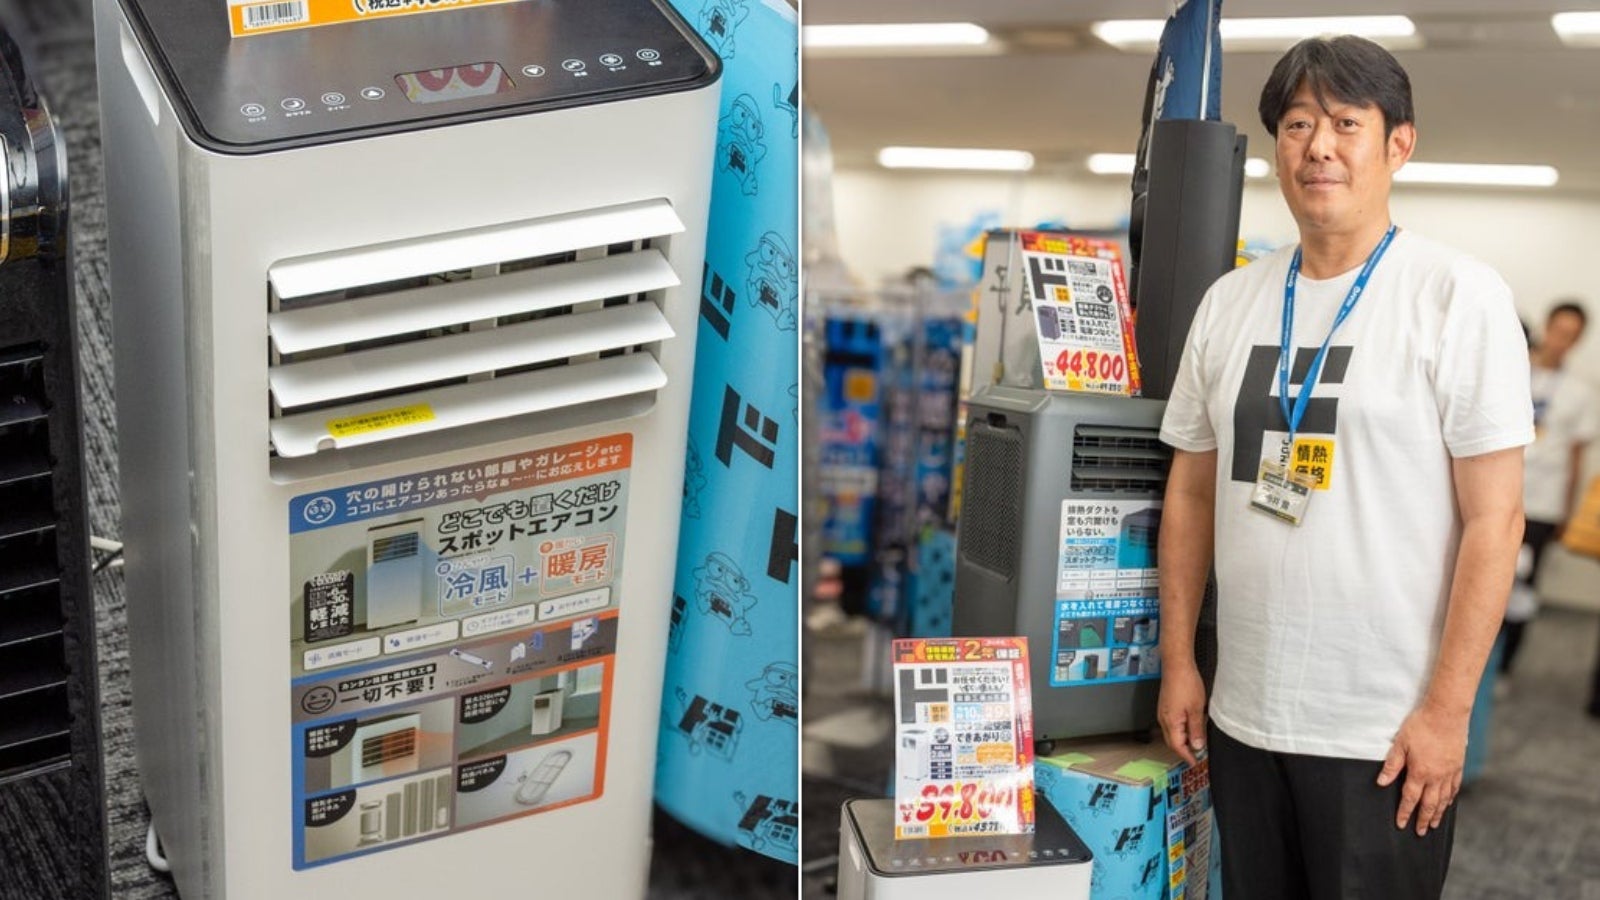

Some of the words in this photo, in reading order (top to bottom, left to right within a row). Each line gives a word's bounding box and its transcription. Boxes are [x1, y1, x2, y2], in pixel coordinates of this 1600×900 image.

[1056, 349, 1124, 382] 44,800
[437, 480, 622, 536] どこでも置くだけ
[438, 504, 621, 556] スポットエアコン
[1067, 506, 1120, 516] 排熱ダクトも
[446, 565, 509, 600] 冷風
[547, 545, 609, 578] 暖房
